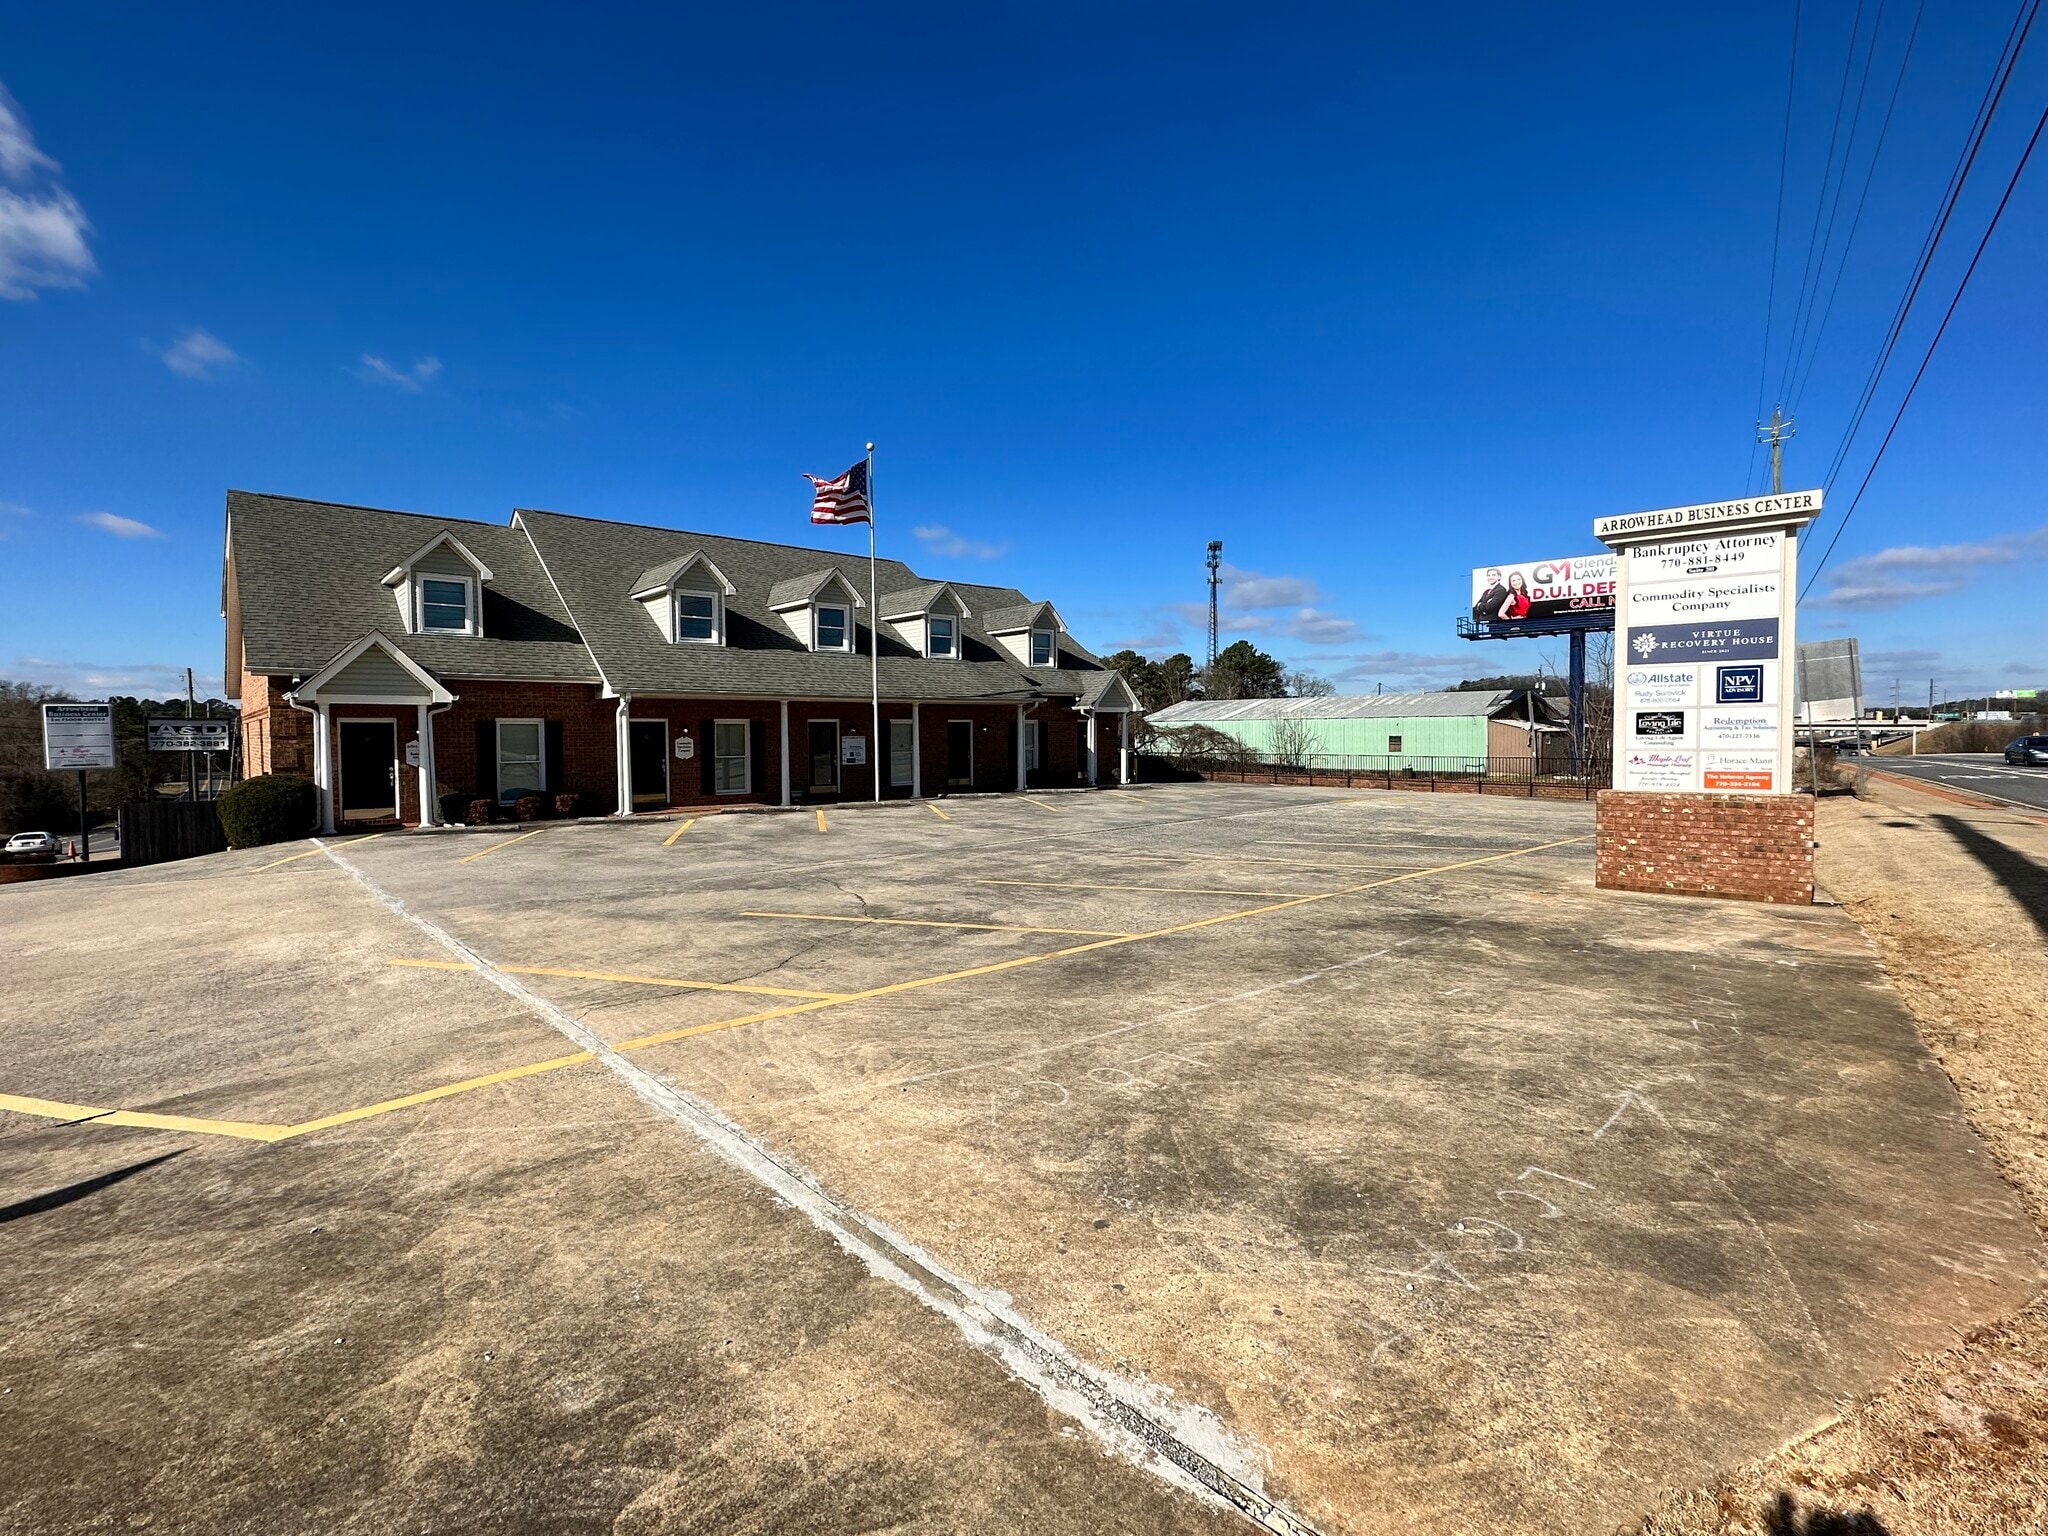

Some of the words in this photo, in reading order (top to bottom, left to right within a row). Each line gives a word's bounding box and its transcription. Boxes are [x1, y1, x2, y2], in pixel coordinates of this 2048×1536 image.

[1601, 511, 1683, 532] ARROWHEAD
[1688, 502, 1749, 521] BUSINESS
[1755, 495, 1812, 513] CENTER
[1633, 541, 1710, 559] Bankruptcy
[1717, 534, 1778, 550] Attorney
[1661, 552, 1745, 569] 770-881-8449
[1574, 568, 1605, 580] LAW
[1533, 585, 1577, 600] D.U.I.
[1633, 589, 1704, 603] Commodity
[1708, 583, 1776, 598] Specialists
[1569, 597, 1605, 609] CALL
[1672, 600, 1731, 613] Company
[1692, 629, 1741, 638] VIRTUE
[1661, 638, 1726, 649] RECOVERY
[1732, 636, 1774, 646] HOUSE
[1647, 673, 1693, 683] Allstate
[1724, 675, 1755, 686] NPV
[1713, 717, 1767, 726] Redemption
